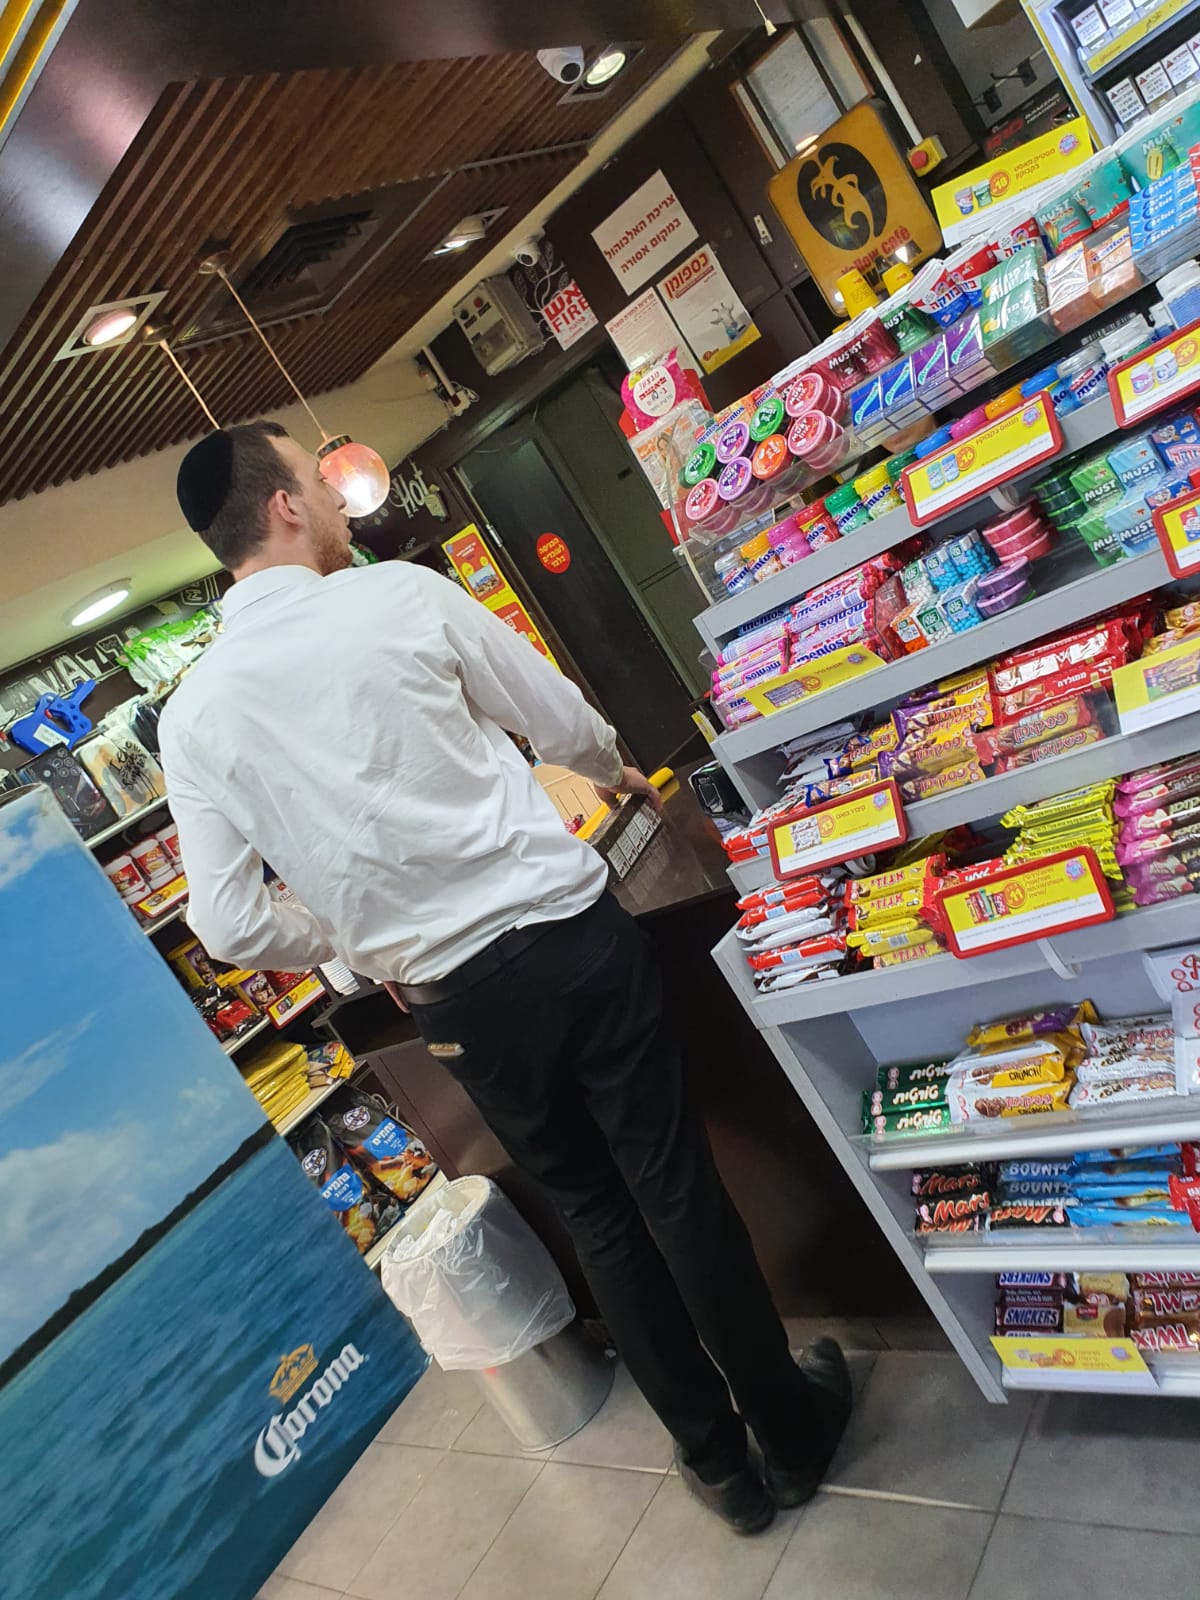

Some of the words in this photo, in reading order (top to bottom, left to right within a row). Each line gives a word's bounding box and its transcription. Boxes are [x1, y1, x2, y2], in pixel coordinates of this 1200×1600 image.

[648, 193, 676, 223] צריכת
[1039, 199, 1071, 226] MUST
[604, 216, 649, 260] האלכוהול
[650, 217, 682, 249] במקום
[620, 246, 652, 274] אסורה
[664, 252, 710, 300] כספומן
[543, 283, 582, 320] אש
[551, 294, 591, 333] FIRE
[720, 406, 745, 431] mentos
[697, 423, 719, 445] mentos
[1122, 460, 1156, 483] MUST
[388, 455, 430, 518] Hot
[1084, 478, 1117, 502] MUST
[1120, 520, 1153, 542] MUST
[796, 589, 843, 619] mentos
[818, 600, 867, 631] mentos
[796, 638, 845, 664] mentos
[744, 660, 782, 681] mentos
[920, 1171, 979, 1195] Mars
[1008, 1162, 1072, 1177] BOUNTY
[1008, 1181, 1073, 1195] BOUNTY
[933, 1191, 991, 1223] Mars
[999, 1272, 1052, 1287] SNICKERS
[1005, 1307, 1060, 1326] SNICKERS
[1131, 1322, 1197, 1352] TWIX
[254, 1342, 364, 1478] Corona
